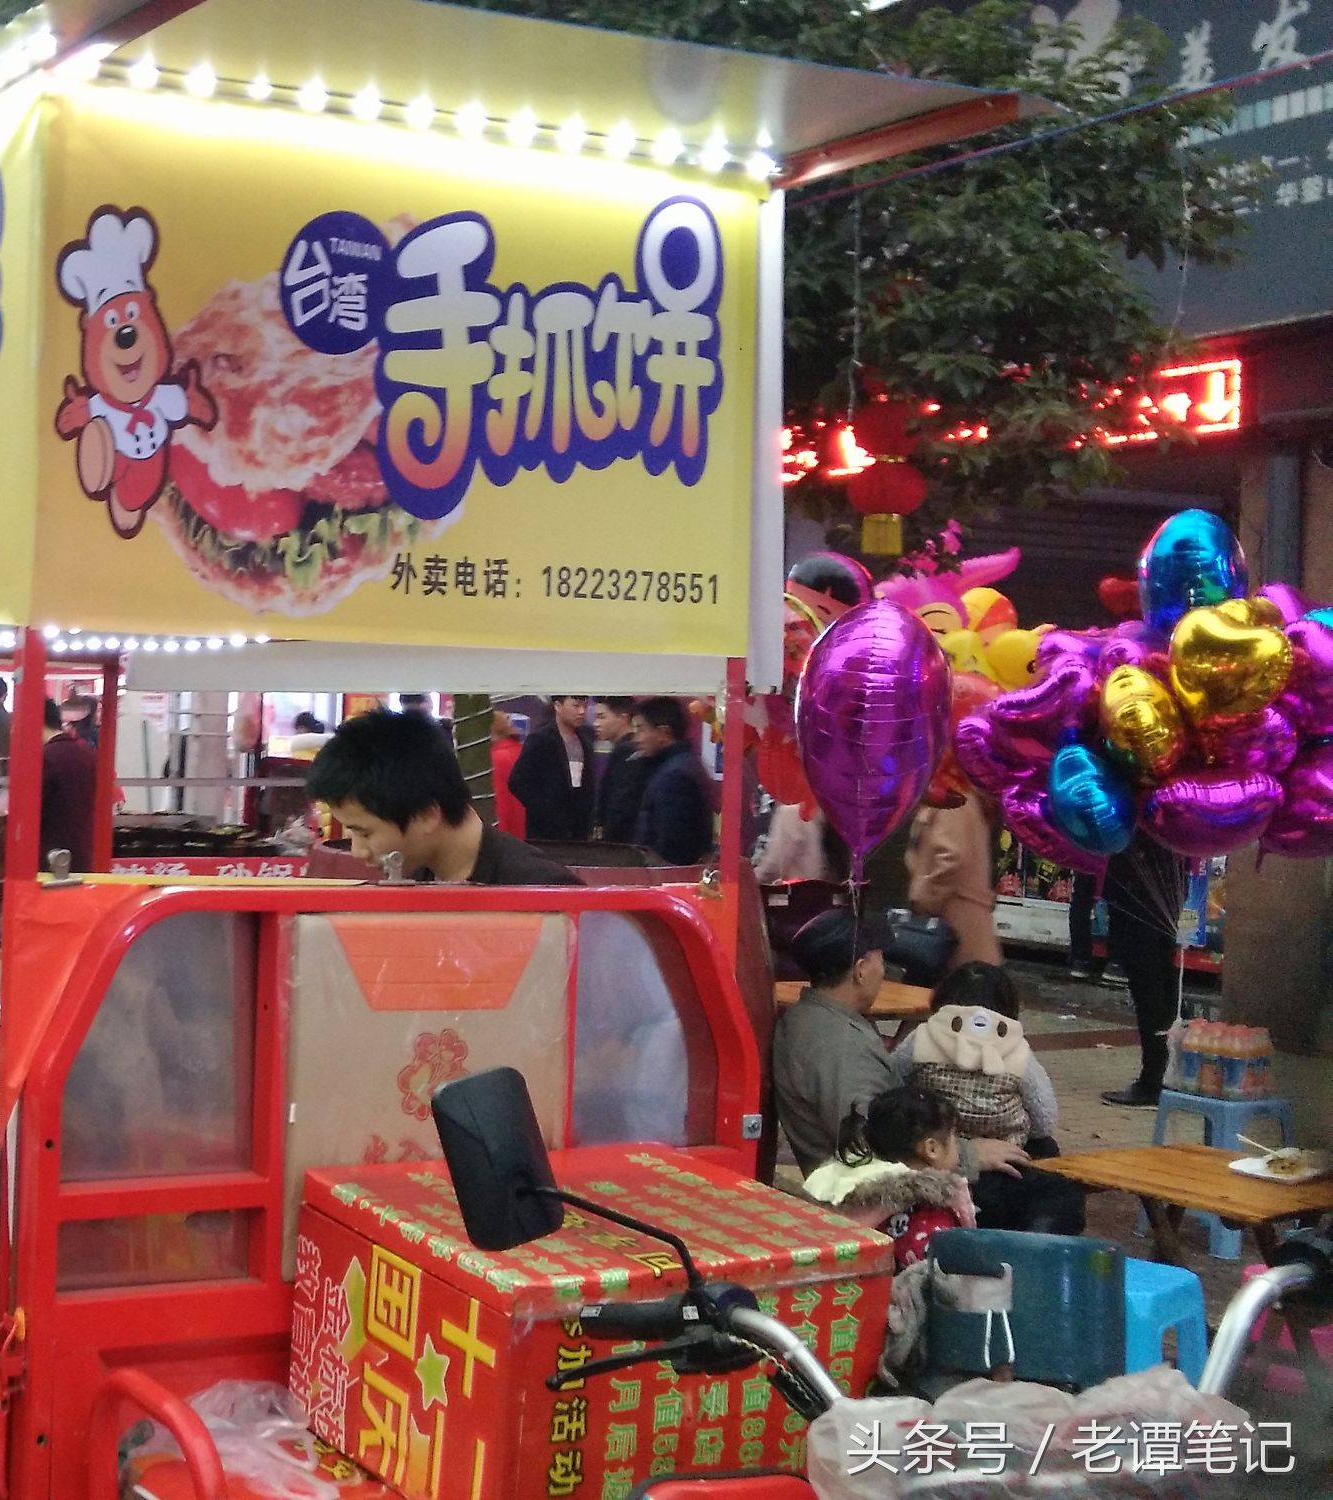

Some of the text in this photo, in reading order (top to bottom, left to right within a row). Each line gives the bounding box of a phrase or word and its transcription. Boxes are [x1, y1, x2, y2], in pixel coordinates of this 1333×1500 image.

[284, 239, 368, 331] 台湾
[384, 202, 717, 489] 手抓饼
[541, 564, 721, 606] 18223278551
[359, 1244, 423, 1487] 国庆
